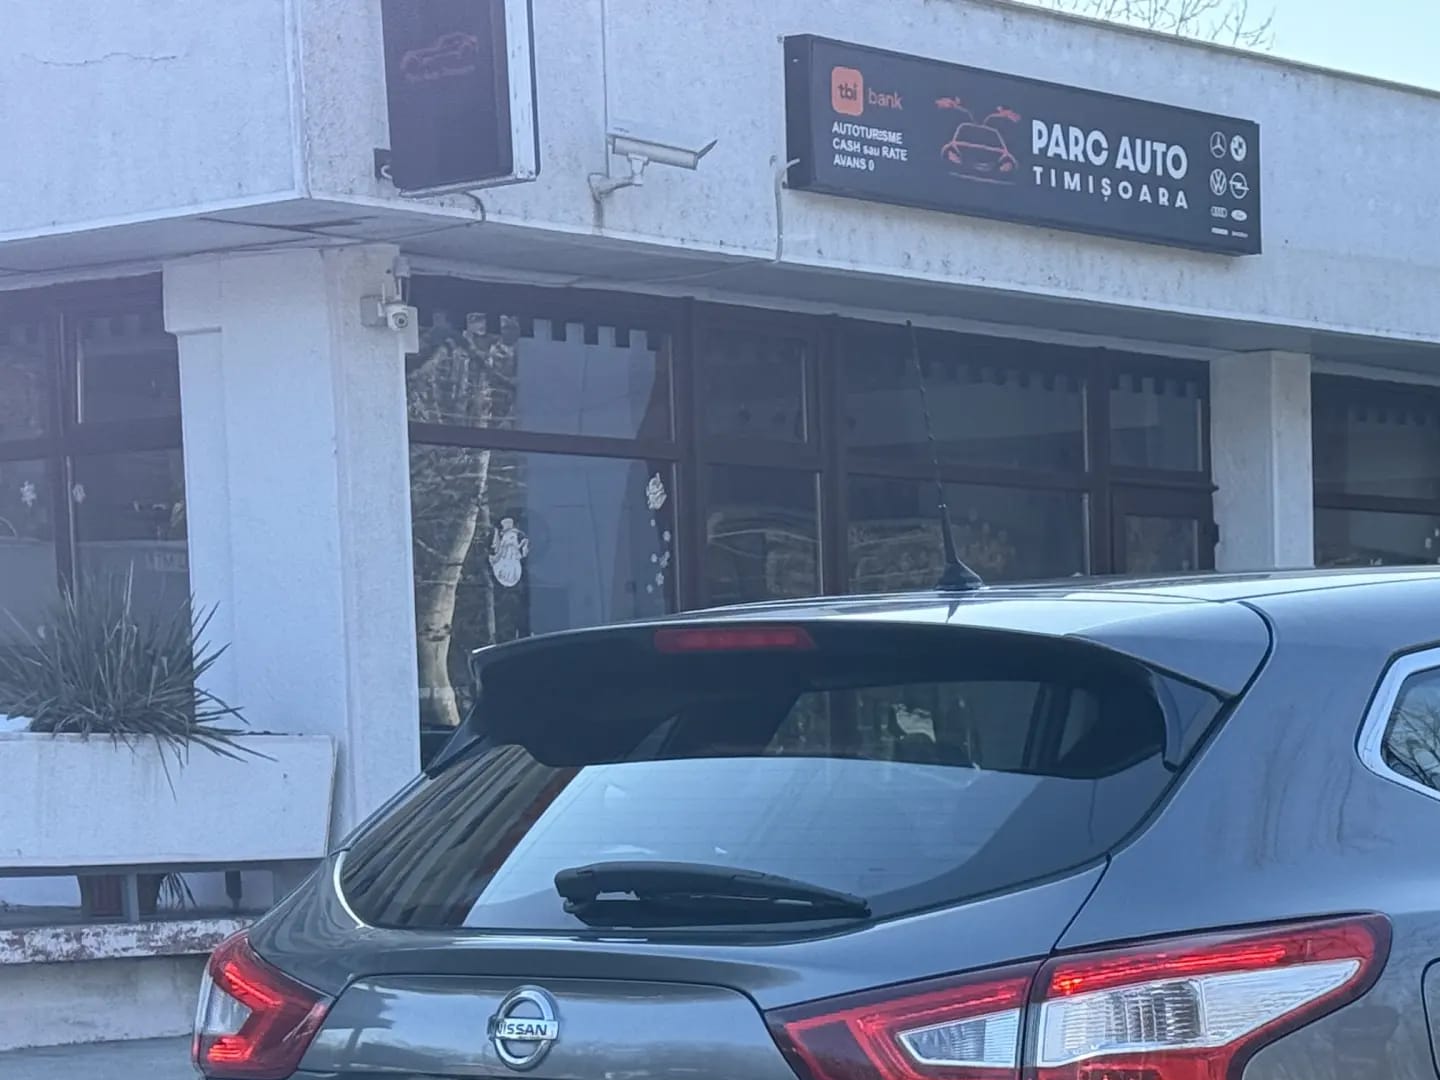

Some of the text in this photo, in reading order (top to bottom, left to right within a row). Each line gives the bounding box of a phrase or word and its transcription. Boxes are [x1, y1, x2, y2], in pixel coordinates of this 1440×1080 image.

[838, 82, 903, 110] tbi bank
[832, 138, 909, 162] CASH sau RATE
[833, 154, 867, 170] AVANS
[1032, 119, 1188, 180] PARC AUTO
[1032, 166, 1189, 209] TIMIȘOARA
[493, 1022, 547, 1036] NISSAN
